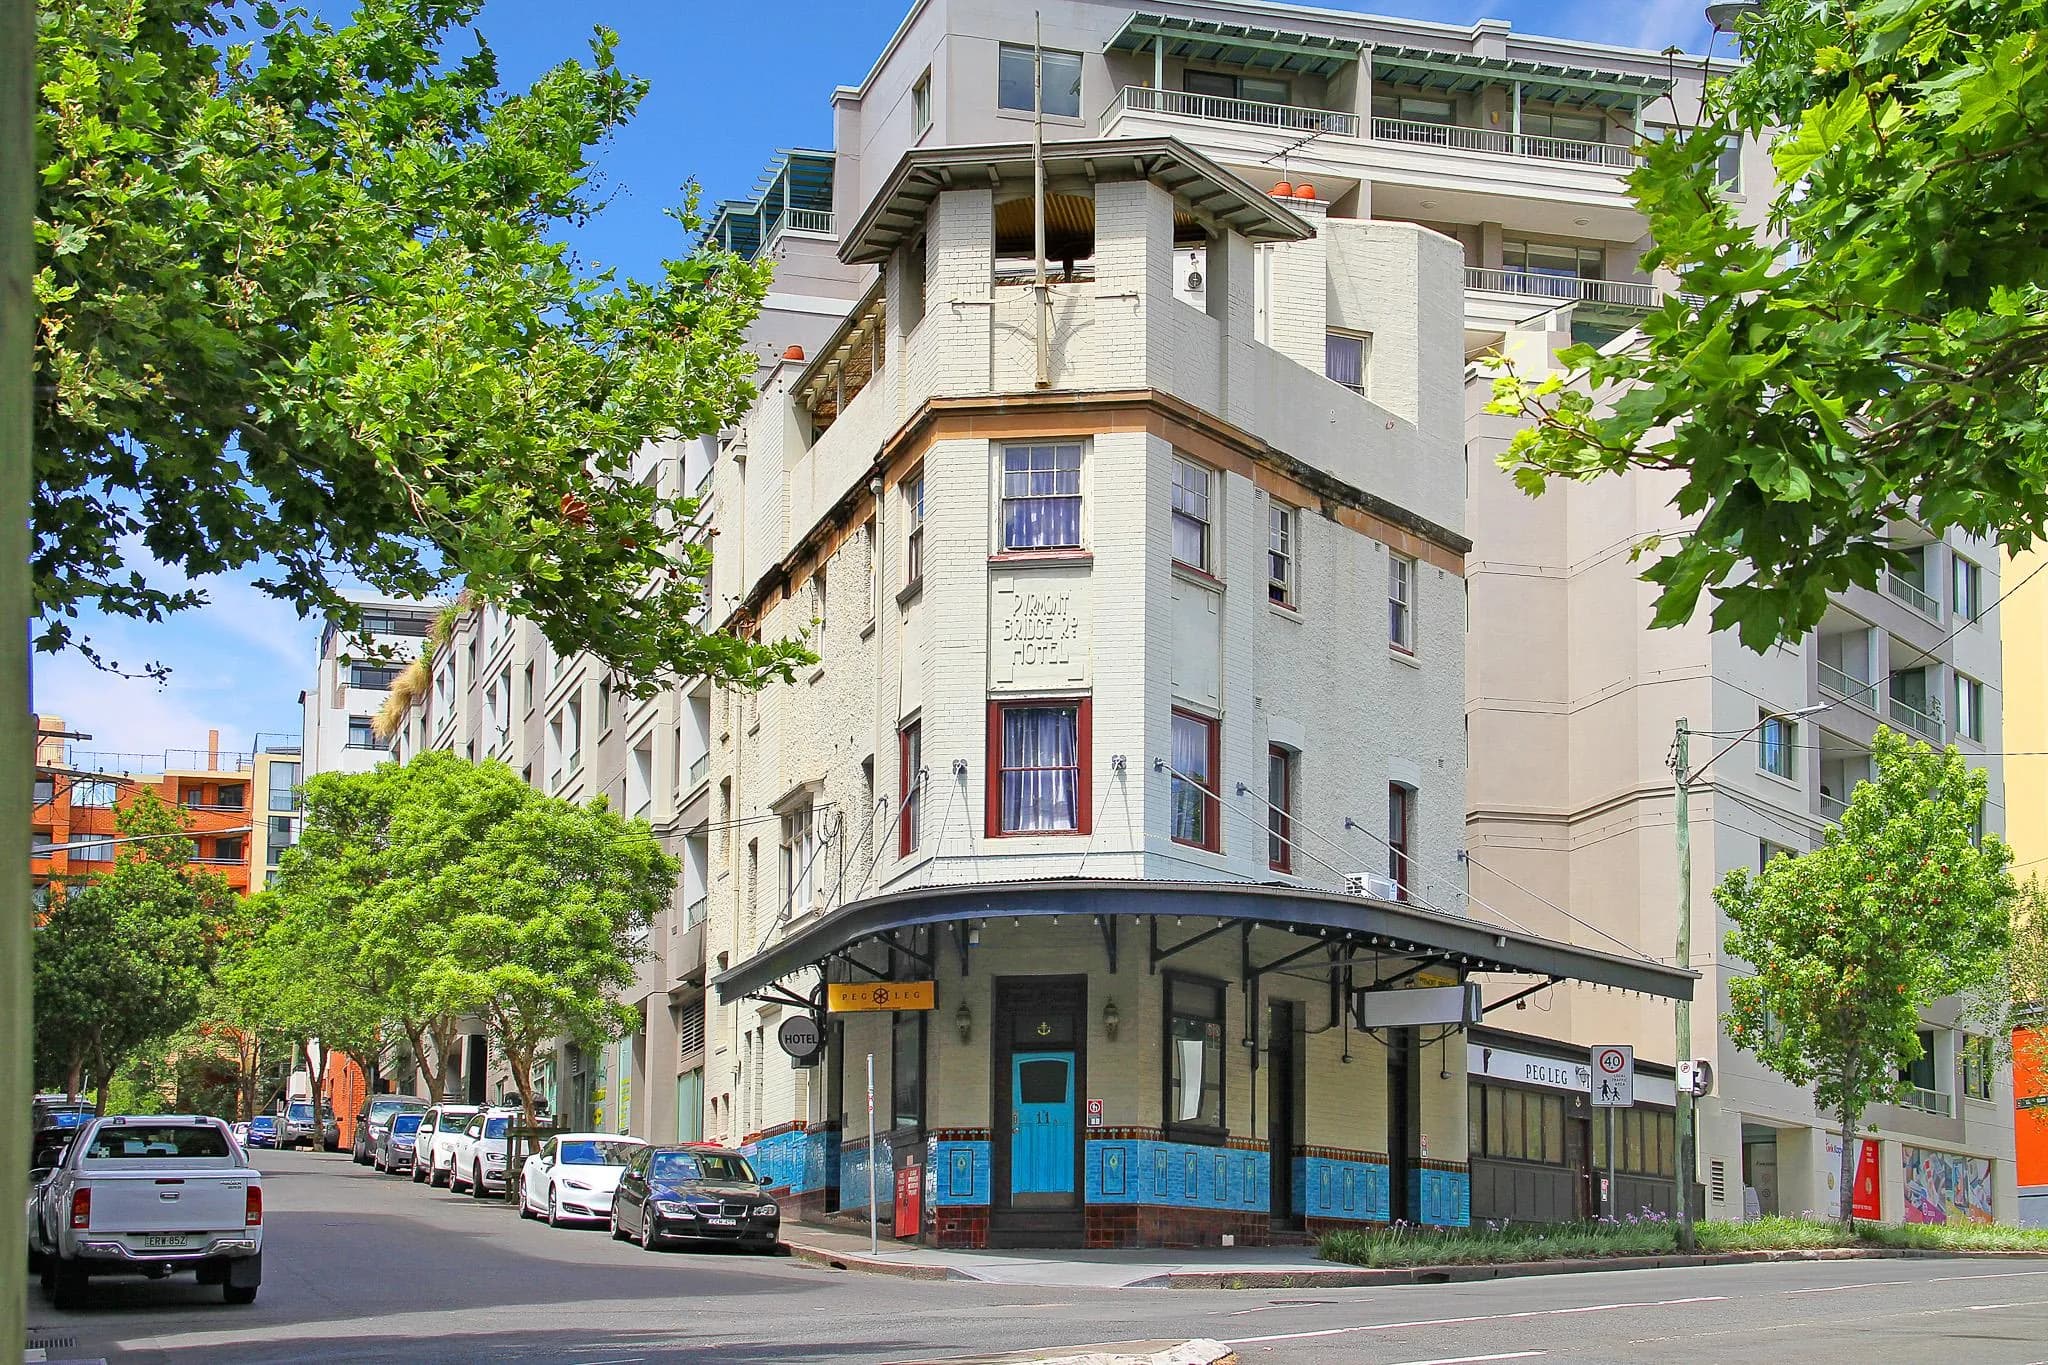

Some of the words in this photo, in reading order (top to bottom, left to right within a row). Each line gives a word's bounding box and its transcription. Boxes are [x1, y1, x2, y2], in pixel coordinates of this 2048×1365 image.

[1012, 592, 1070, 616] PYRMONT
[1003, 618, 1054, 641] BRIDGE
[1012, 641, 1070, 665] HOTEL
[842, 992, 868, 1001] PEG
[895, 991, 921, 1000] LEG
[784, 1033, 818, 1045] HOTEL
[1604, 1056, 1621, 1067] 40
[1525, 1064, 1546, 1081] PEG
[1548, 1067, 1568, 1085] LEG
